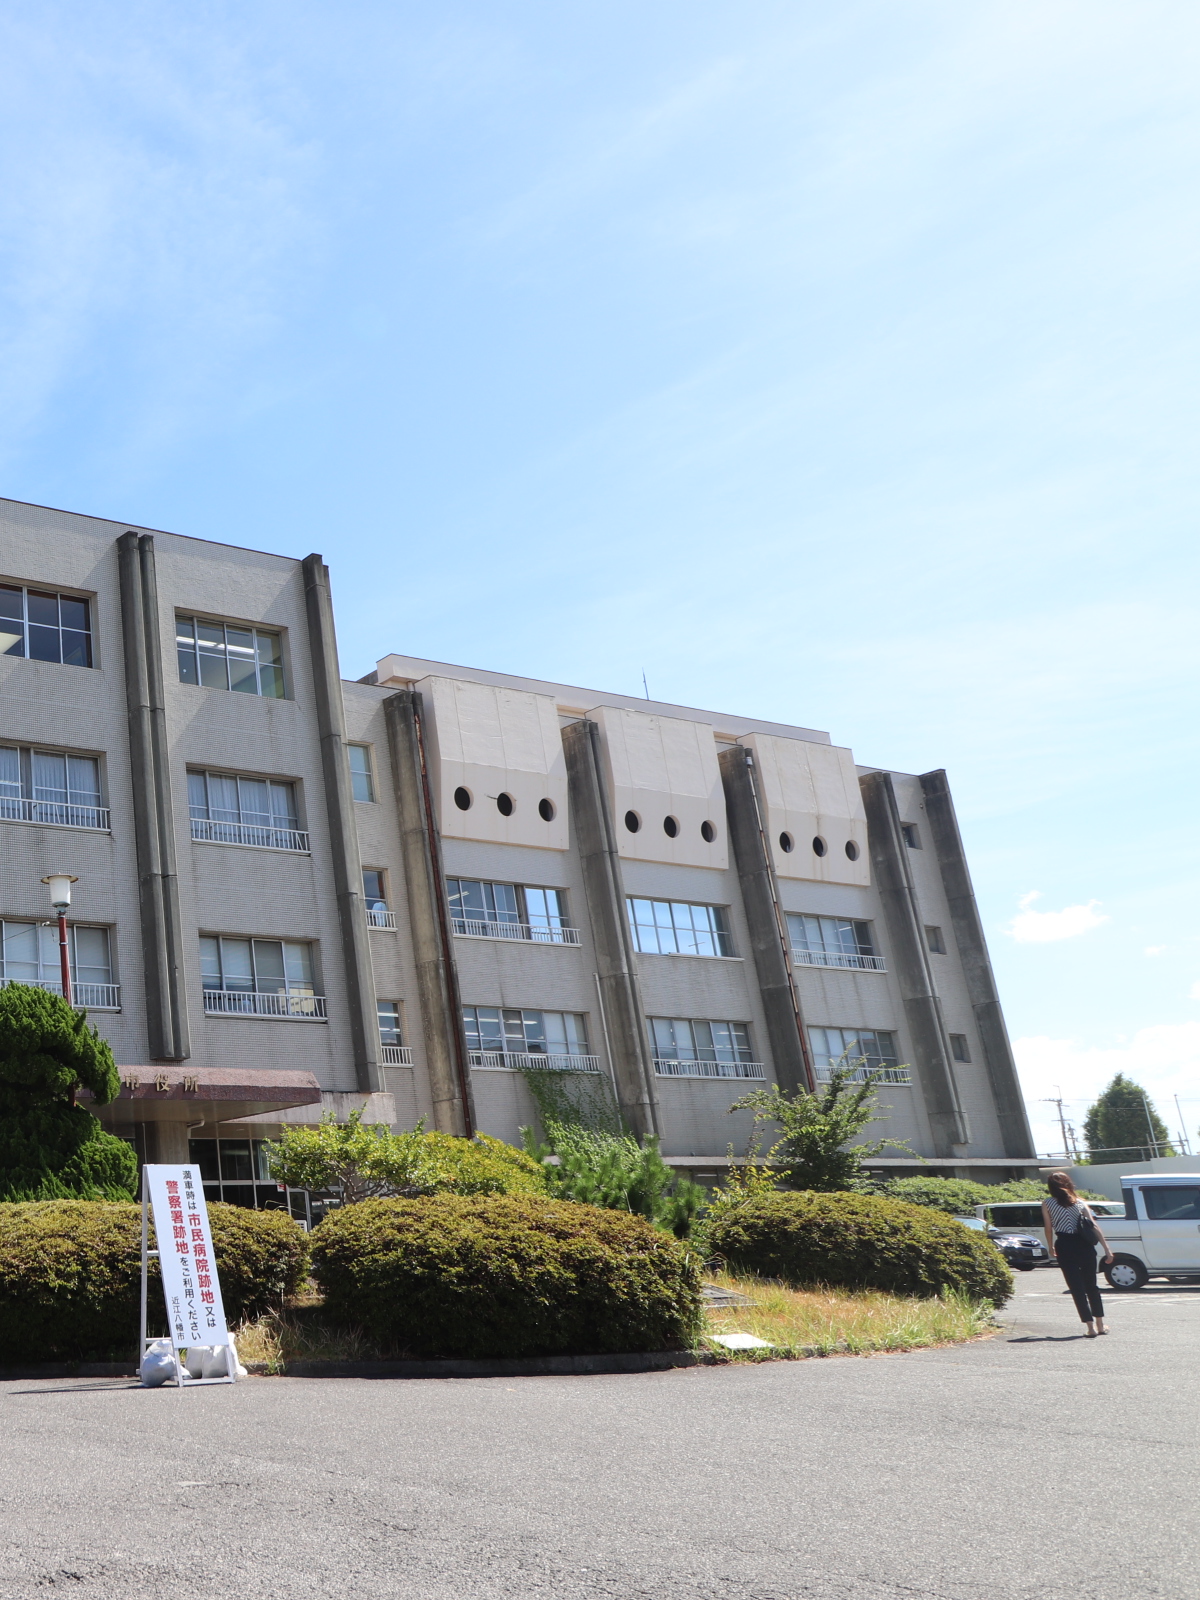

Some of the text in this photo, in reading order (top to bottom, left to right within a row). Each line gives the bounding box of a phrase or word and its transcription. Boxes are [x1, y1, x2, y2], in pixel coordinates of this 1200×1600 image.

[165, 1180, 202, 1341] 警察署跡地をご利用ください
[171, 1296, 185, 1341] 近江八幡市
[182, 1170, 217, 1328] 満車時は市民病院跡地又は
